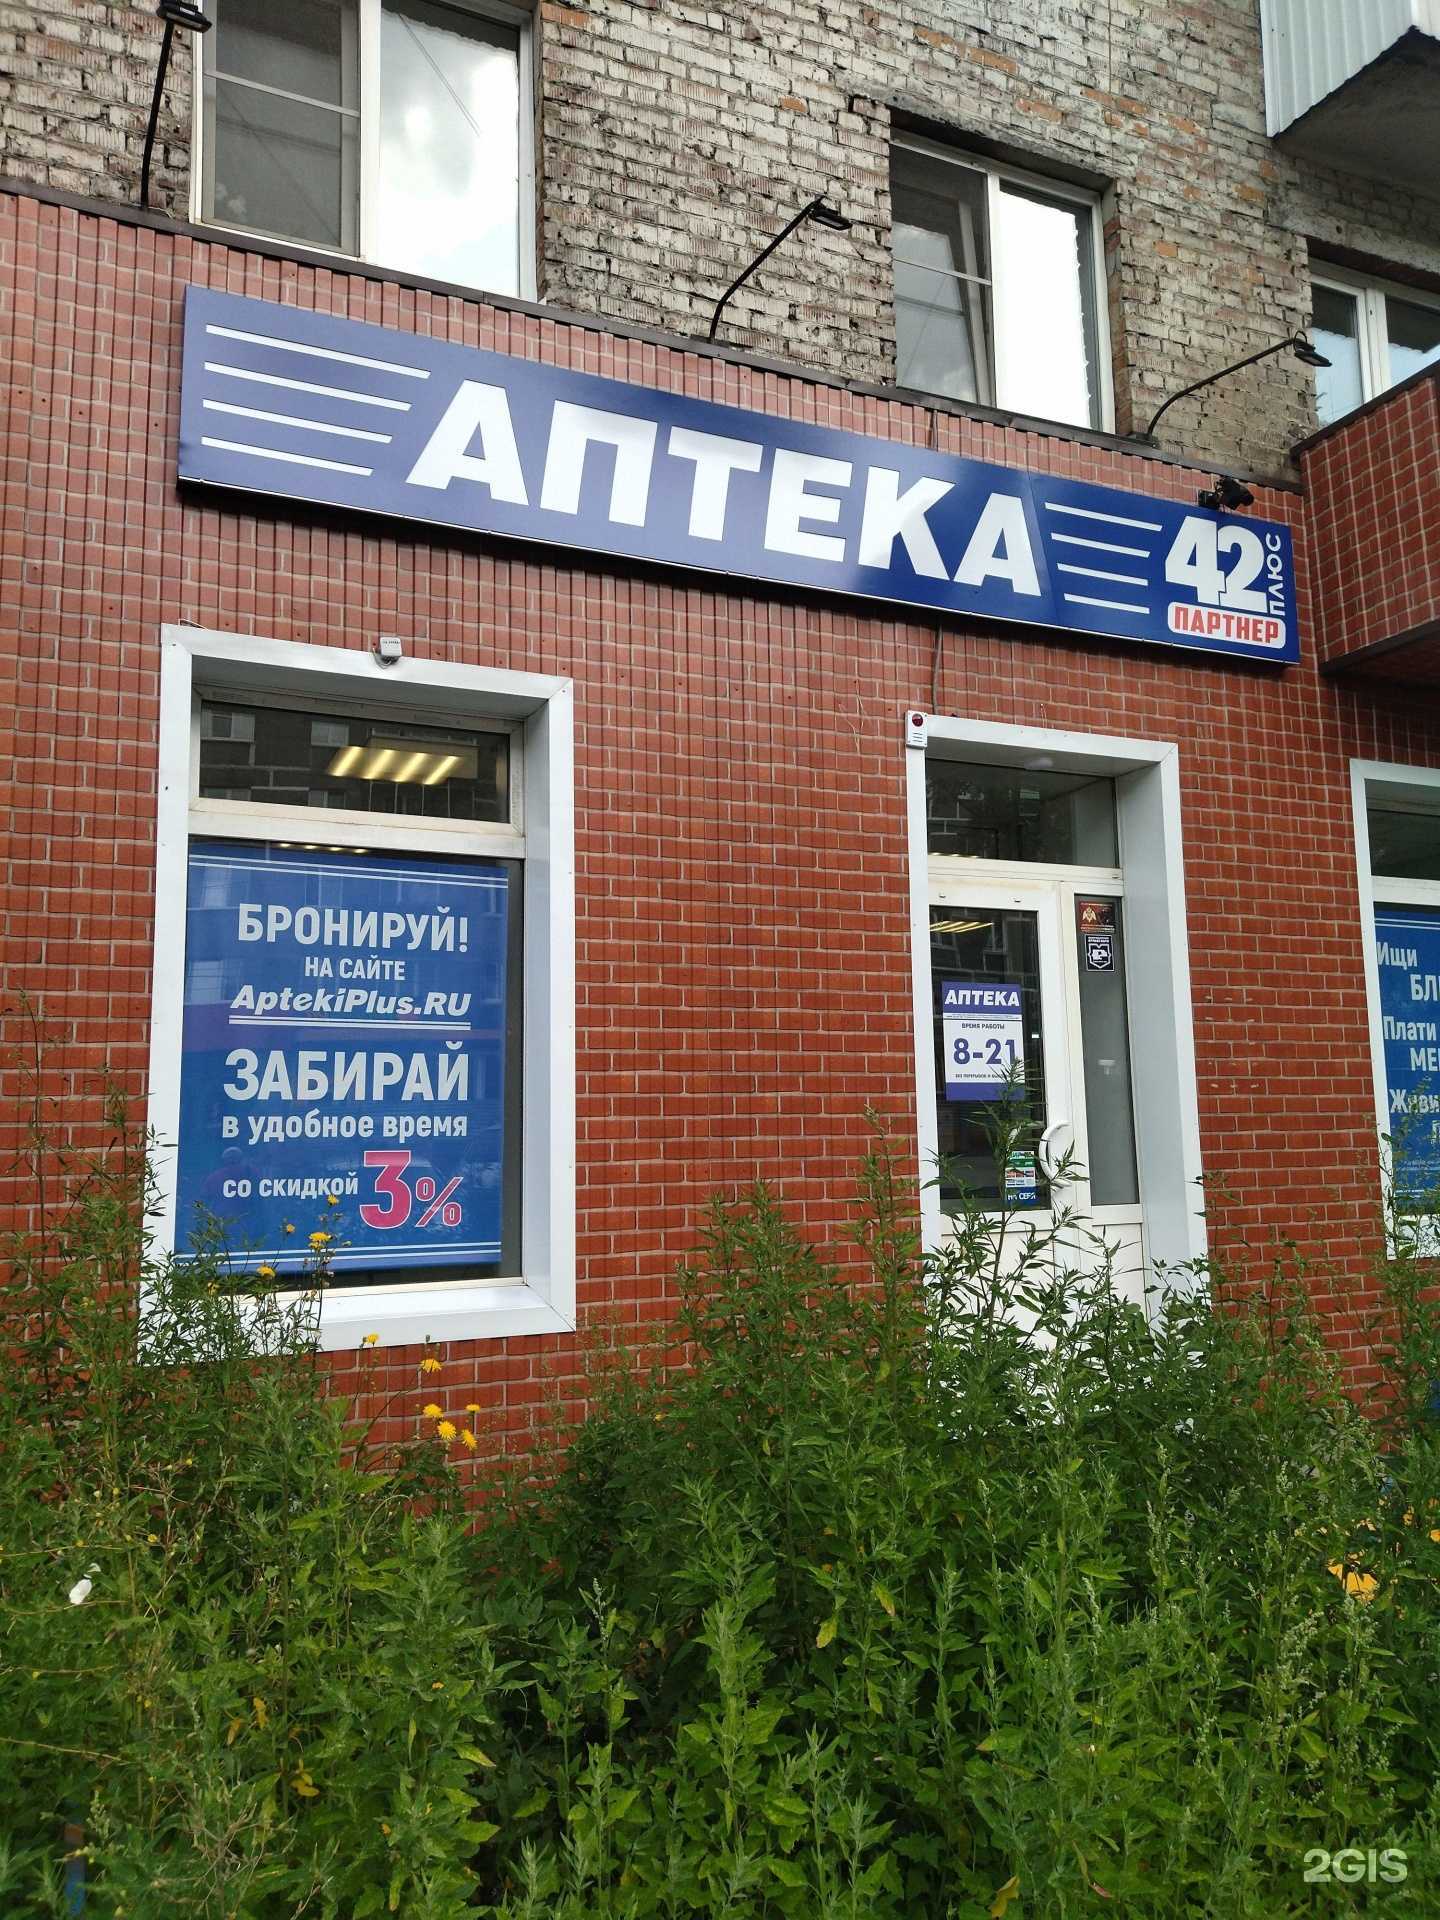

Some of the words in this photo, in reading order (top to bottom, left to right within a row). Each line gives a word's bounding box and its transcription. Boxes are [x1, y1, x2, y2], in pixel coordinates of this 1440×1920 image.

[404, 379, 1043, 597] АПТЕКА
[1165, 515, 1268, 613] 42
[1265, 532, 1286, 616] ПЛЮС
[1174, 606, 1279, 644] ПАРТНЕР
[237, 902, 469, 954] БРОНИРУЙ!
[304, 956, 333, 978] НА
[339, 955, 406, 981] САЙТЕ
[1376, 941, 1418, 971] Ищи
[230, 984, 472, 1017] AptekiPlus.RU
[944, 989, 1020, 1007] АПТЕКА
[1409, 973, 1440, 1002] БЛ
[1382, 1015, 1437, 1041] Плати
[953, 1037, 1016, 1065] 8-21
[1409, 1047, 1440, 1072] МЕ
[223, 1040, 469, 1101] ЗАБИРАЙ
[222, 1114, 239, 1139] в
[247, 1108, 374, 1144] удобное
[383, 1113, 468, 1144] время
[222, 1177, 254, 1198] со
[258, 1171, 359, 1199] скидкой
[359, 1150, 464, 1230] 3%
